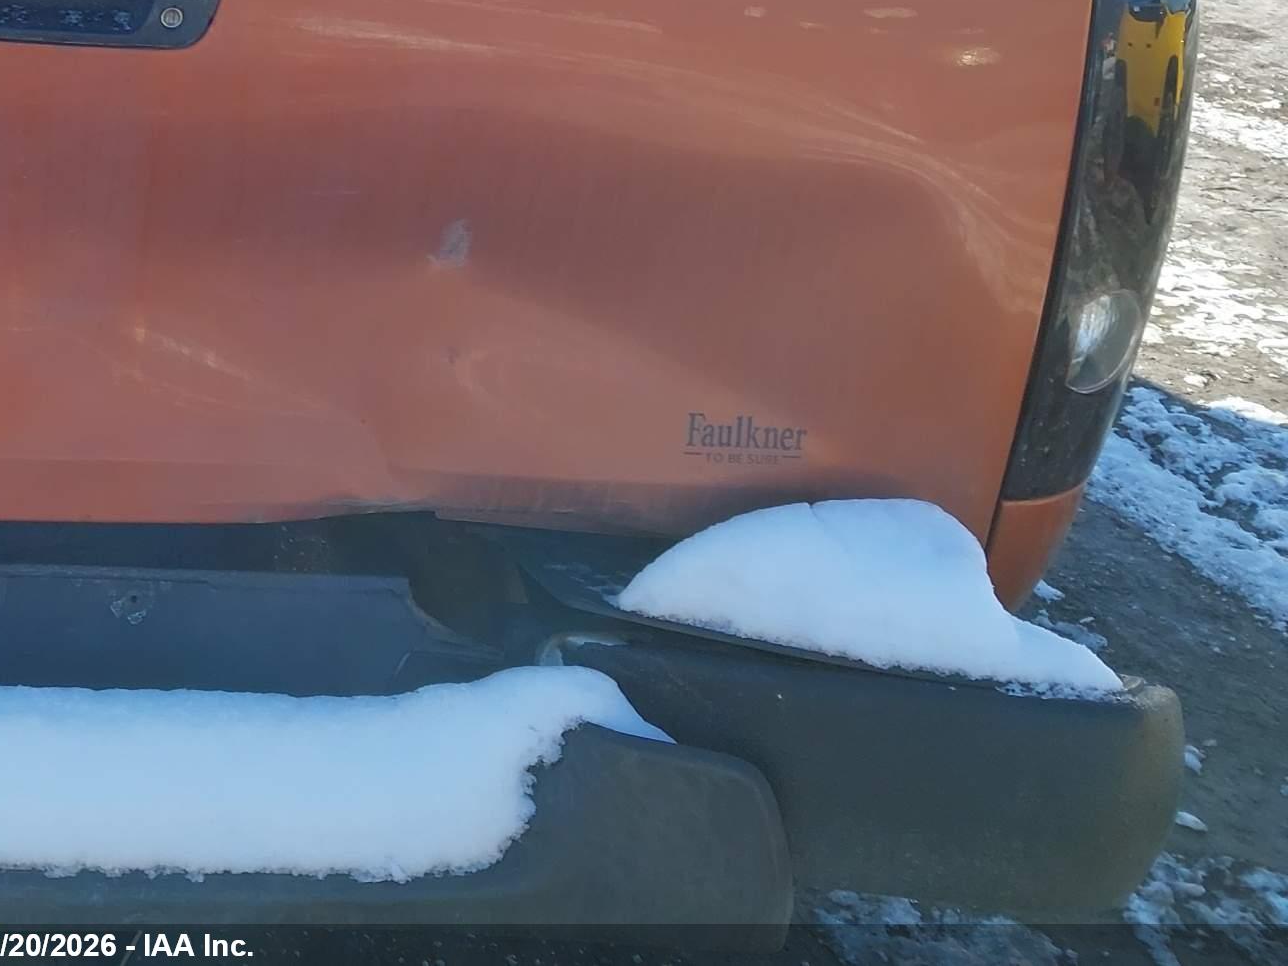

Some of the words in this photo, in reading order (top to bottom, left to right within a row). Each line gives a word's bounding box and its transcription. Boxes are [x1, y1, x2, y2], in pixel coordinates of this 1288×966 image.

[685, 411, 808, 451] Faulkner
[705, 453, 724, 463] TO
[728, 454, 743, 464] BE
